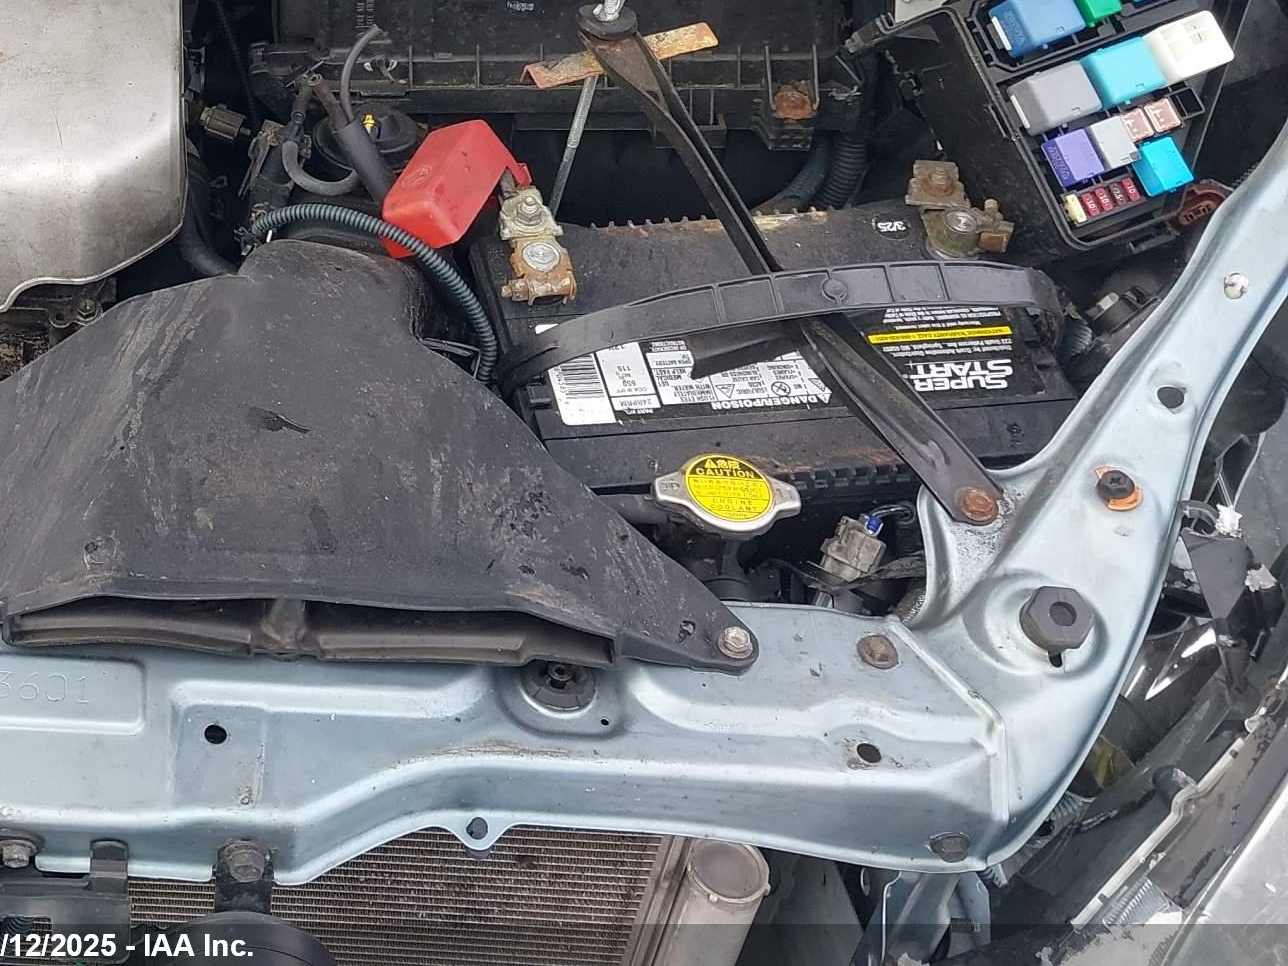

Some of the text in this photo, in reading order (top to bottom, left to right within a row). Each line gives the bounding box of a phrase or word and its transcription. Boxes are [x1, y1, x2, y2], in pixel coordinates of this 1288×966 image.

[877, 221, 907, 232] 3/25
[910, 358, 1013, 379] START
[913, 375, 1008, 392] SUPER
[711, 395, 817, 411] DANGER/POISON
[695, 467, 754, 479] CAUTION
[712, 498, 753, 506] ENGINE
